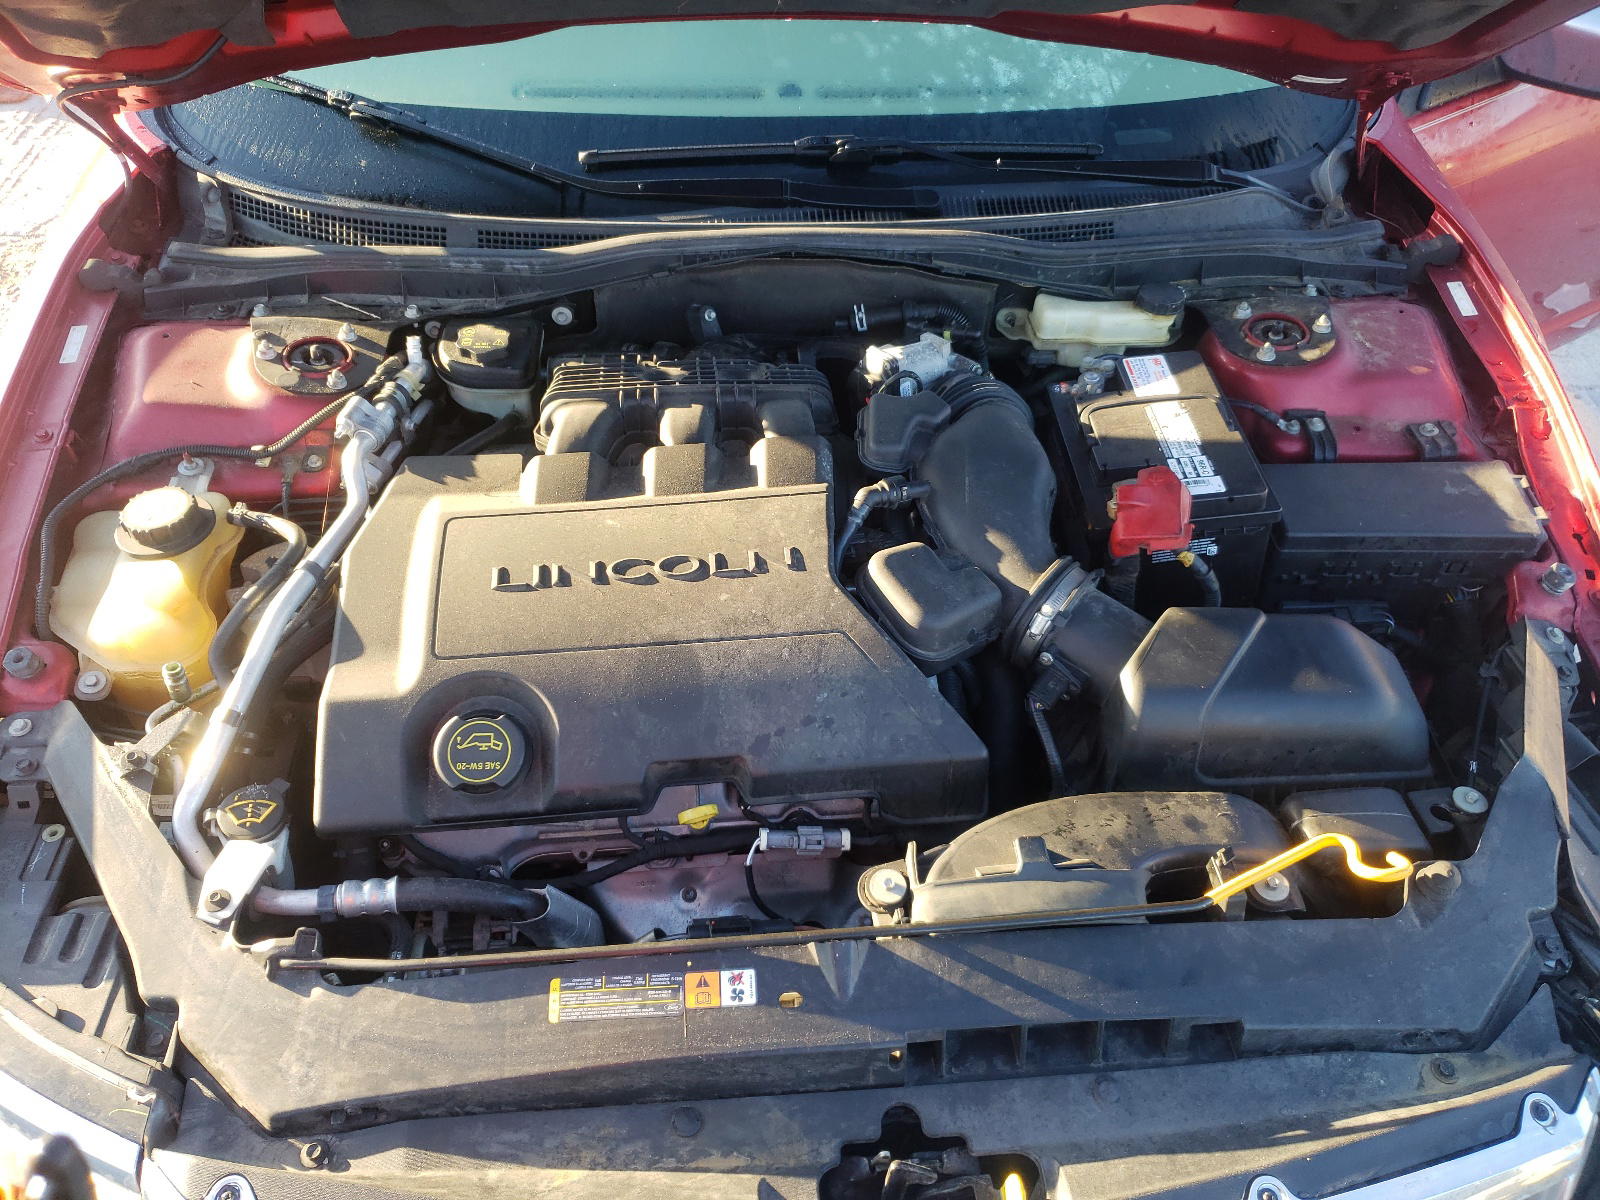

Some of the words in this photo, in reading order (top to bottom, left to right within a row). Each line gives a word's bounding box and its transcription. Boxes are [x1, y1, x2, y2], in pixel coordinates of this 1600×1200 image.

[491, 546, 807, 592] LINCOLN
[456, 762, 483, 770] 5W-20
[484, 762, 501, 770] SAE
